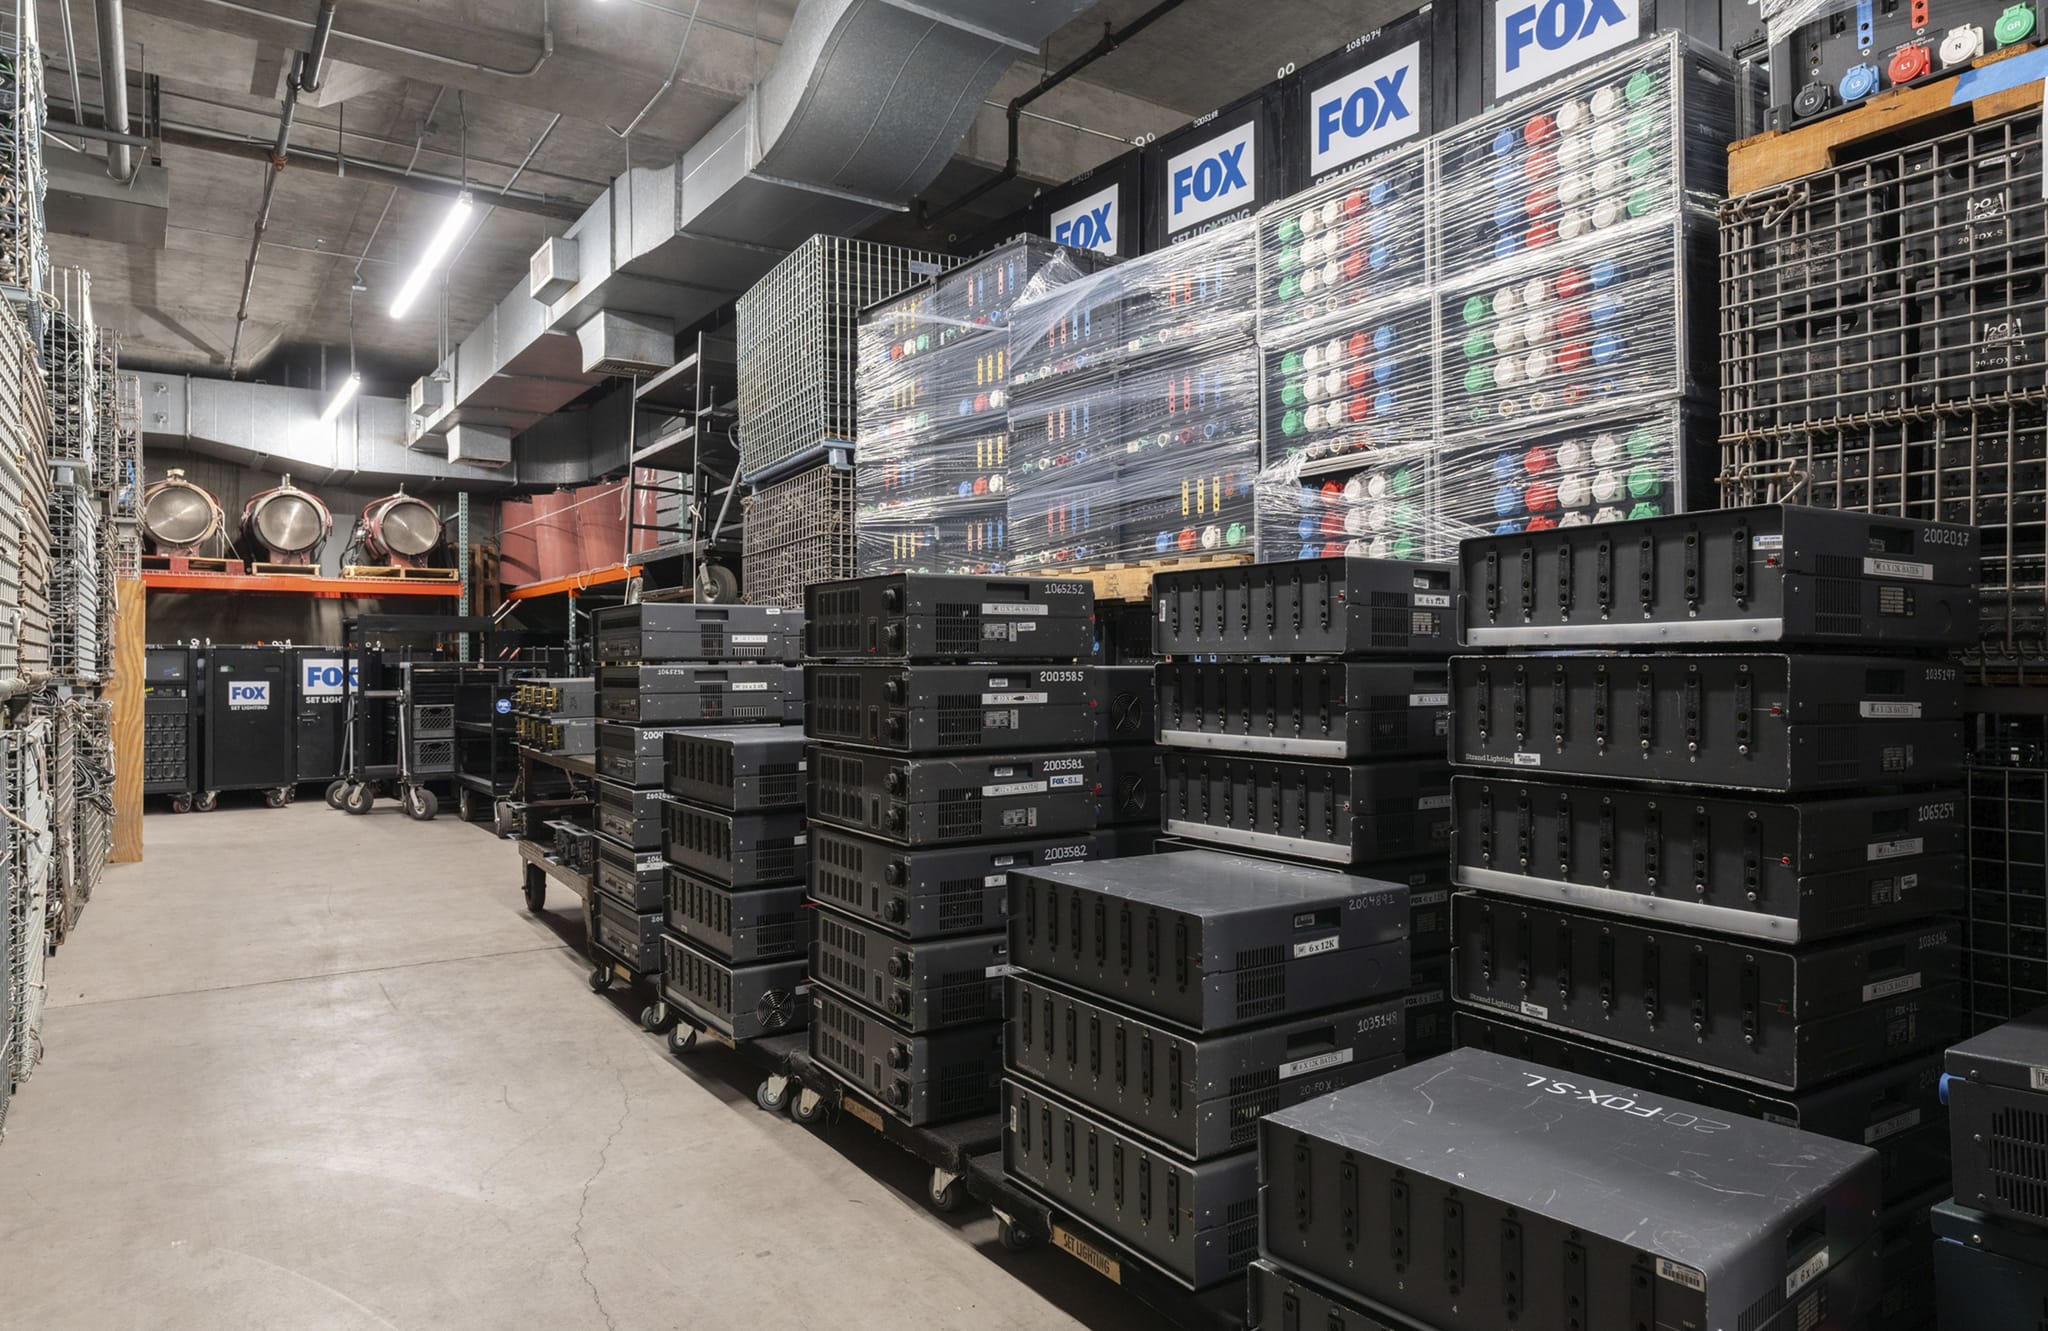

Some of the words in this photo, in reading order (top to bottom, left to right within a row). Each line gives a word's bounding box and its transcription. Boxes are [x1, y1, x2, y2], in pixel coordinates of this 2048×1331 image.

[2007, 20, 2021, 30] GR
[1955, 42, 1962, 50] N
[1901, 62, 1910, 70] L1
[1851, 80, 1861, 88] L2
[1804, 97, 1814, 105] L3
[1319, 65, 1410, 155] FOX
[1174, 141, 1247, 215] FOX
[1055, 202, 1112, 249] FOX
[1172, 232, 1191, 246] SET
[1924, 528, 1969, 546] 2002017
[1045, 583, 1085, 594] 1065252
[308, 667, 359, 687] FOX
[1040, 671, 1084, 682] 2003585
[232, 687, 266, 700] FOX
[306, 696, 320, 704] SET
[643, 731, 664, 740] 2004
[1043, 759, 1084, 771] 2003581
[1465, 753, 1486, 762] Strand
[1487, 754, 1514, 765] Lighting
[1918, 802, 1954, 822] 1065254
[1045, 845, 1088, 860] 2003582
[1349, 894, 1395, 911] 2004891
[1309, 945, 1314, 953] 6
[1320, 939, 1335, 950] 12K
[1492, 997, 1520, 1013] Lighting
[1357, 1011, 1398, 1033] 1035148
[1063, 1233, 1074, 1250] SET
[1076, 1239, 1110, 1274] LIGHTING
[1302, 1239, 1307, 1247] 1
[1347, 1260, 1354, 1268] 2
[1451, 1304, 1458, 1313] 4
[1800, 1269, 1805, 1282] 6
